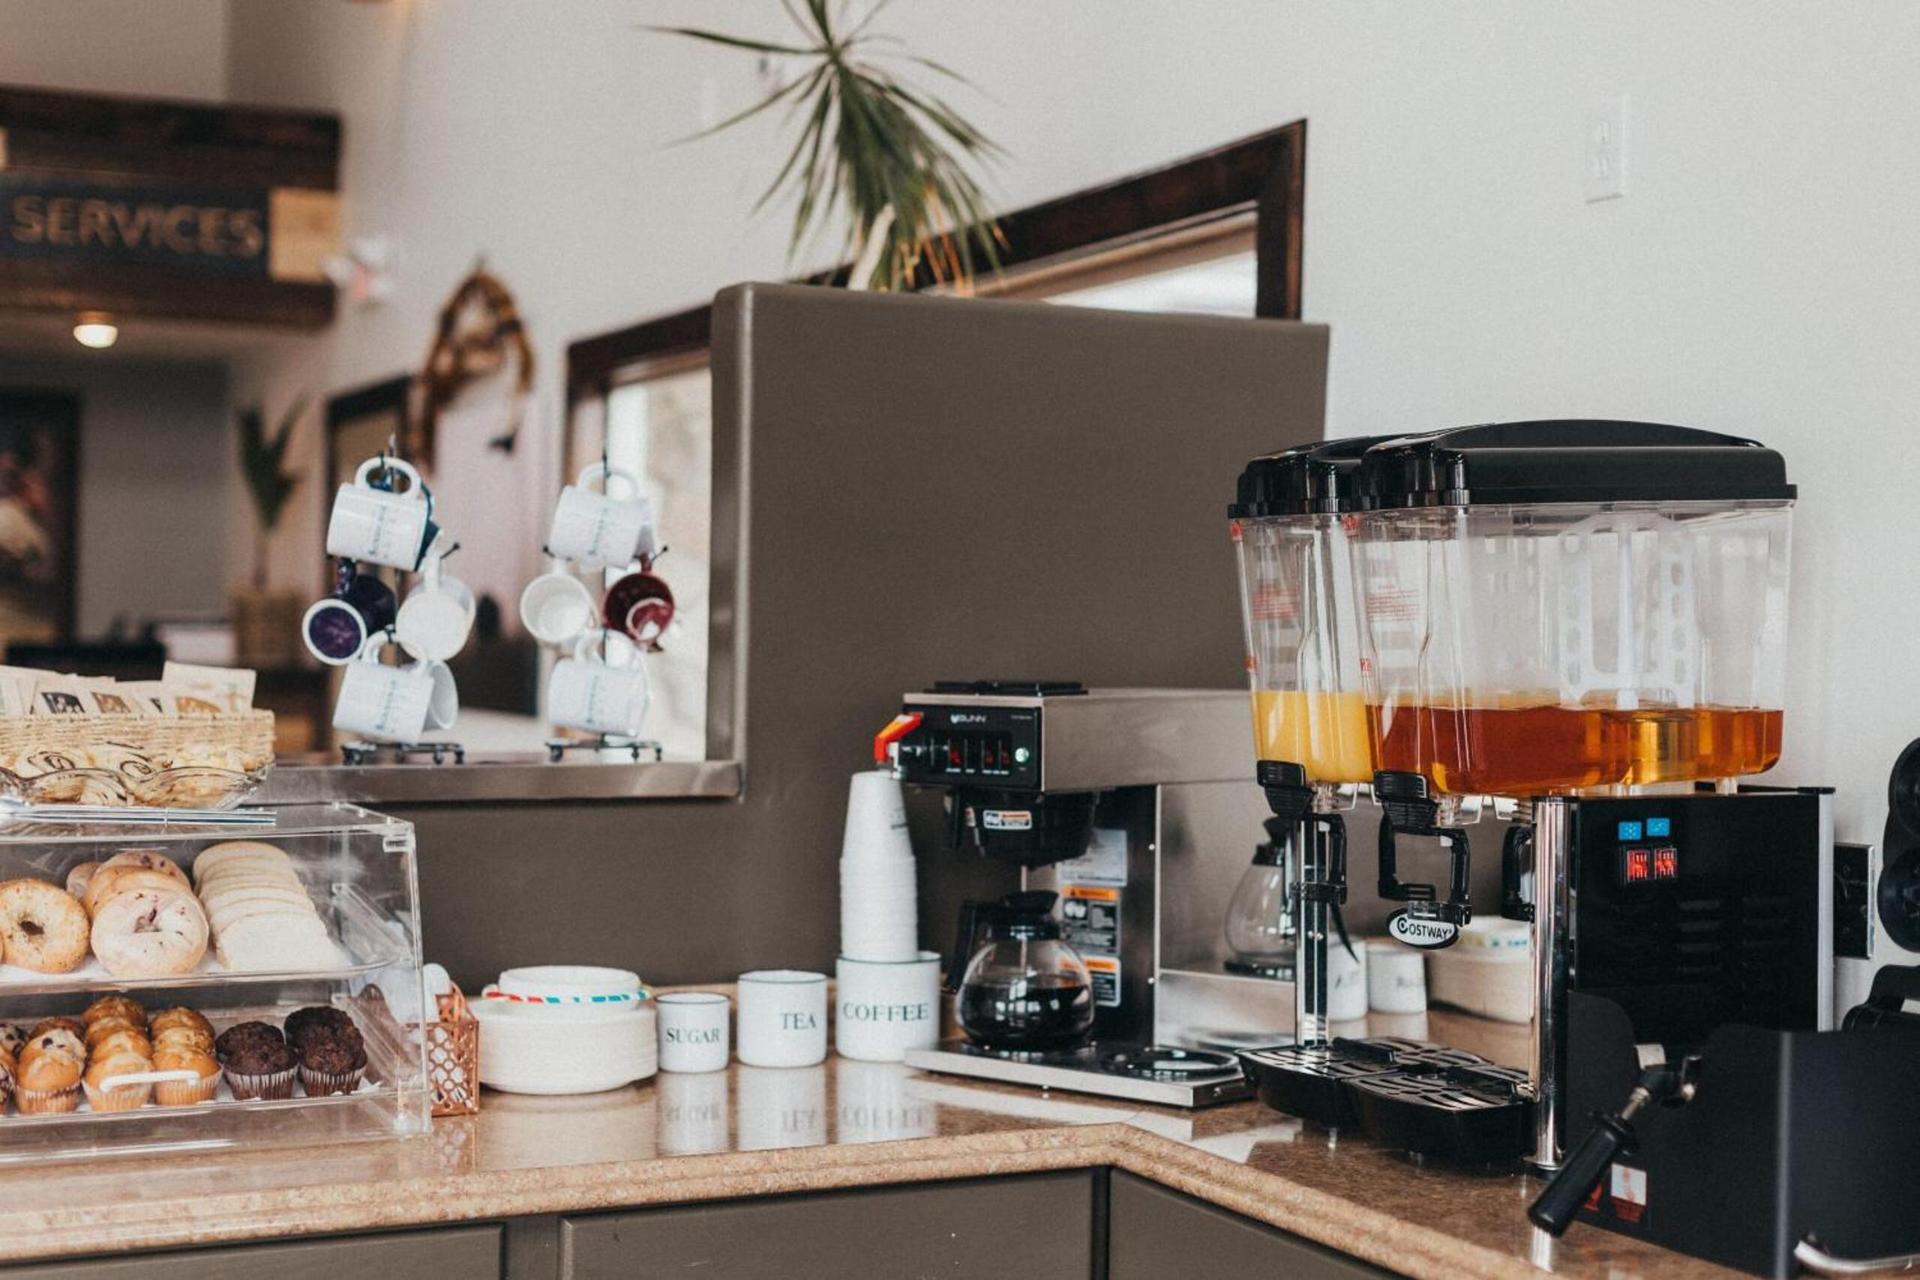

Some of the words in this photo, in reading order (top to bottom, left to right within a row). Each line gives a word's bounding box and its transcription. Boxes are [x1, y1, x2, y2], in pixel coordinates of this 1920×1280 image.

[11, 195, 264, 257] SERVICES
[779, 1012, 816, 1031] TEA
[842, 1002, 929, 1022] COFFEE
[666, 1028, 721, 1043] SUGAR
